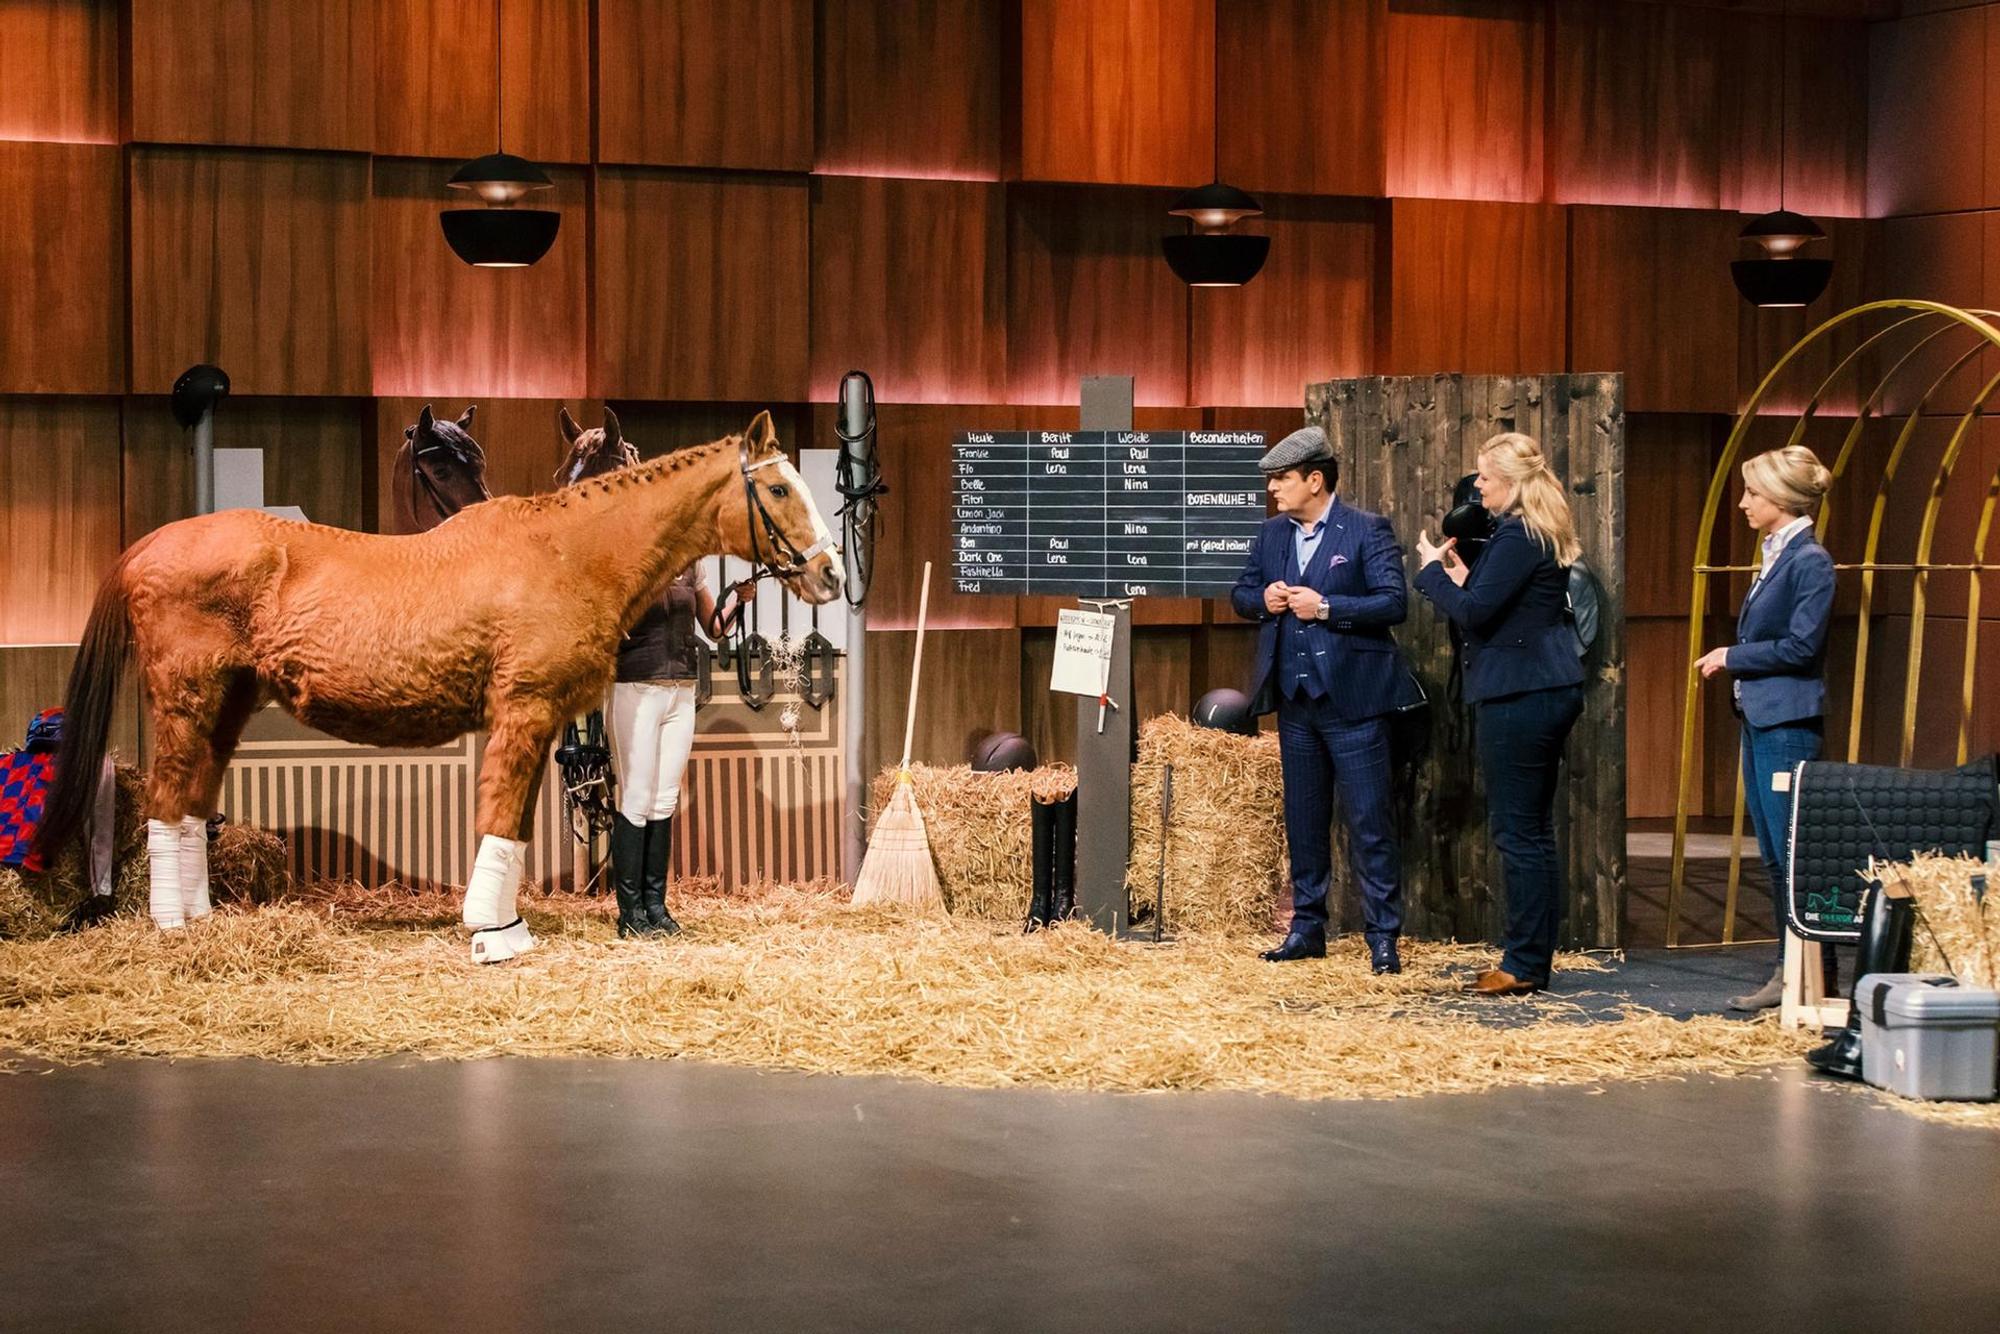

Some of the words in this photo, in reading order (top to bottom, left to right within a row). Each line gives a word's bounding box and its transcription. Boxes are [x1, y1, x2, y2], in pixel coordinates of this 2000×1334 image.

[967, 431, 995, 444] Heute
[1041, 431, 1073, 444] Beritt
[1117, 432, 1150, 444] Weide
[1051, 447, 1070, 459] Paul
[1129, 447, 1149, 460] Paul
[958, 463, 974, 475] Flo
[1045, 462, 1067, 475] Lena
[1123, 462, 1147, 474] Lena
[960, 478, 986, 491] Belle
[1124, 478, 1149, 490] Nina
[1124, 523, 1148, 535] Nina
[1049, 538, 1069, 550] Paul
[958, 551, 983, 563] Dark
[986, 552, 1004, 563] One
[1046, 552, 1068, 564] Lena
[1126, 554, 1148, 565] Lena
[958, 580, 981, 593] Fred
[1124, 583, 1147, 596] Lena
